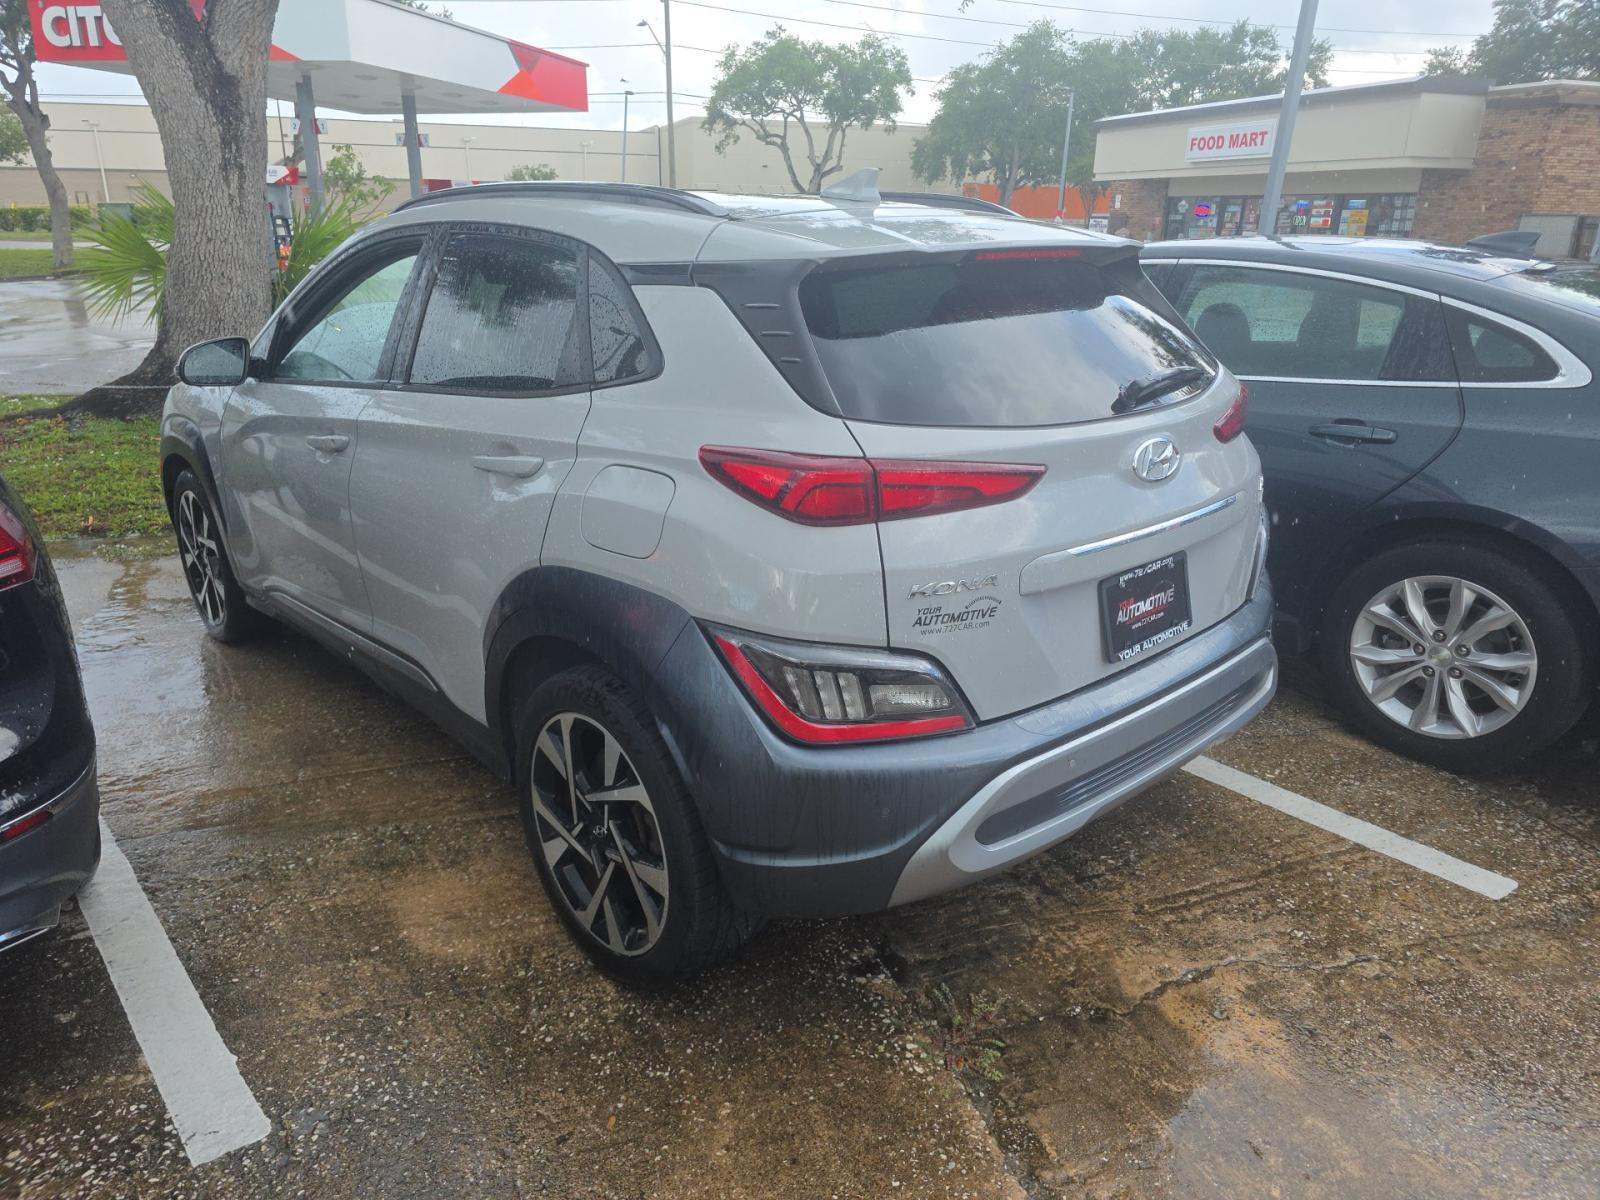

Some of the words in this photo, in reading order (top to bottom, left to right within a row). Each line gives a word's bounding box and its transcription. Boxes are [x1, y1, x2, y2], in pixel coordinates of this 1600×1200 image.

[1190, 135, 1225, 152] FOOD
[1228, 130, 1268, 149] MART
[905, 574, 999, 600] KONA
[912, 605, 998, 627] AUTOMOTIVE
[917, 606, 942, 616] YOUR
[1116, 588, 1175, 625] AUTOMOTIVE
[920, 620, 990, 636] www.727CAR.com
[1118, 645, 1141, 661] YOUR
[1143, 620, 1190, 651] AUTOMOTIVE
